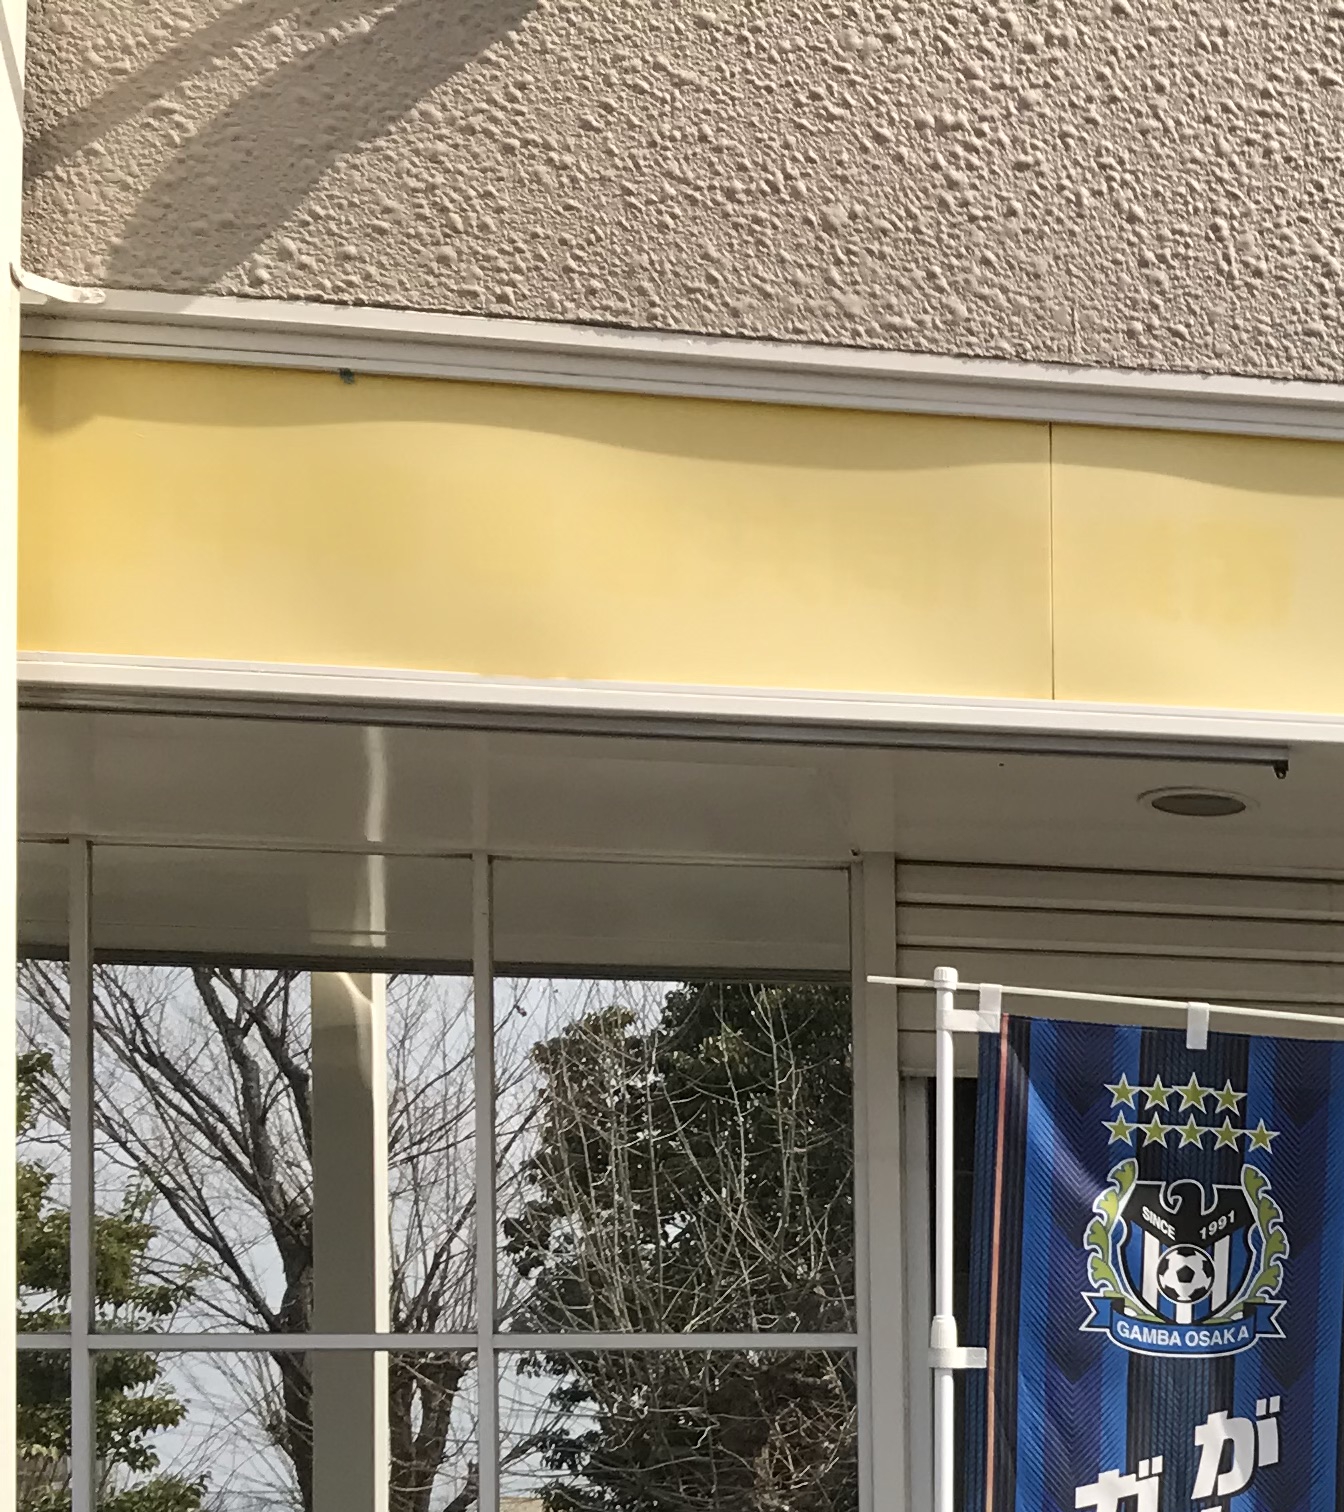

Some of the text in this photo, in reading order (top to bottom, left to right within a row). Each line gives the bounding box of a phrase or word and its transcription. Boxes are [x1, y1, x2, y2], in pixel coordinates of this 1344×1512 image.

[1141, 1206, 1235, 1241] SINCE 1991
[1116, 1320, 1249, 1347] GAMBA OSAKA
